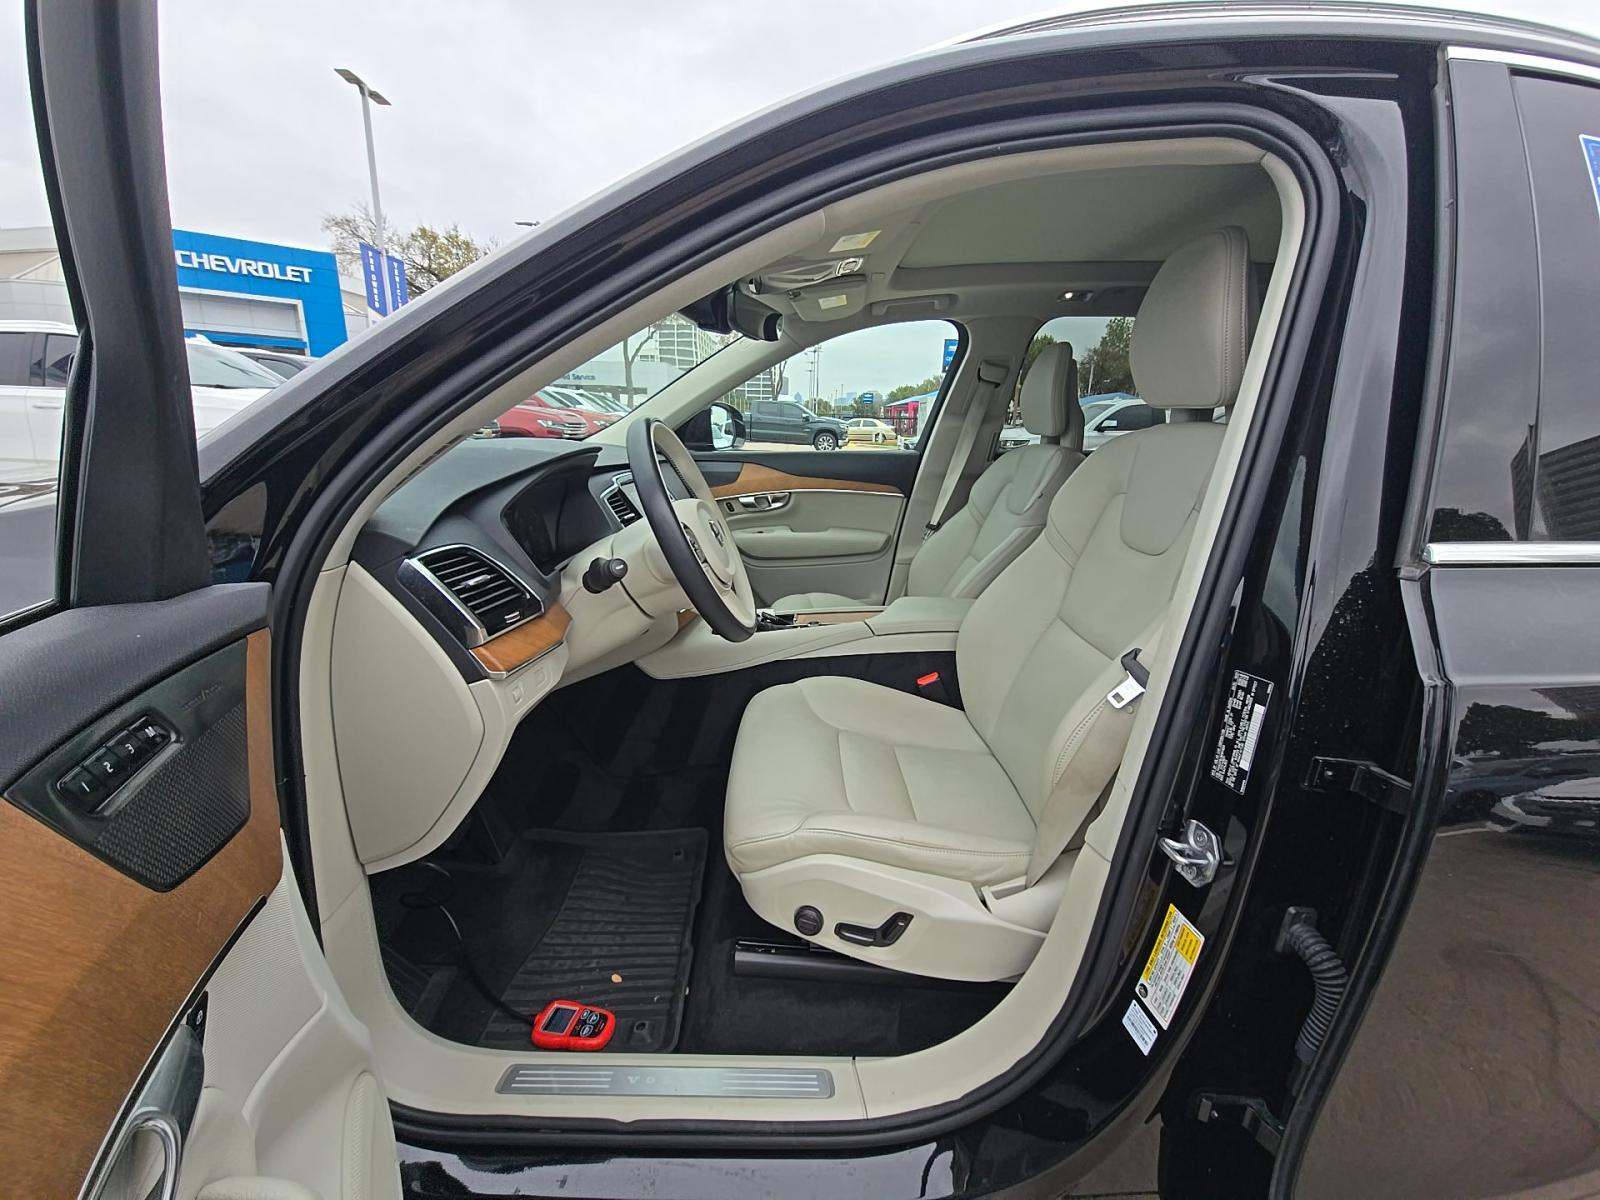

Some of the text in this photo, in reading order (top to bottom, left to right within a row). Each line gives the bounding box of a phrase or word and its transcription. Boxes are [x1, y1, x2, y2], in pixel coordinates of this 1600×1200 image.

[174, 249, 313, 283] CHEVROLET
[81, 781, 90, 792] 1
[103, 761, 114, 773] 2
[125, 743, 135, 754] 3
